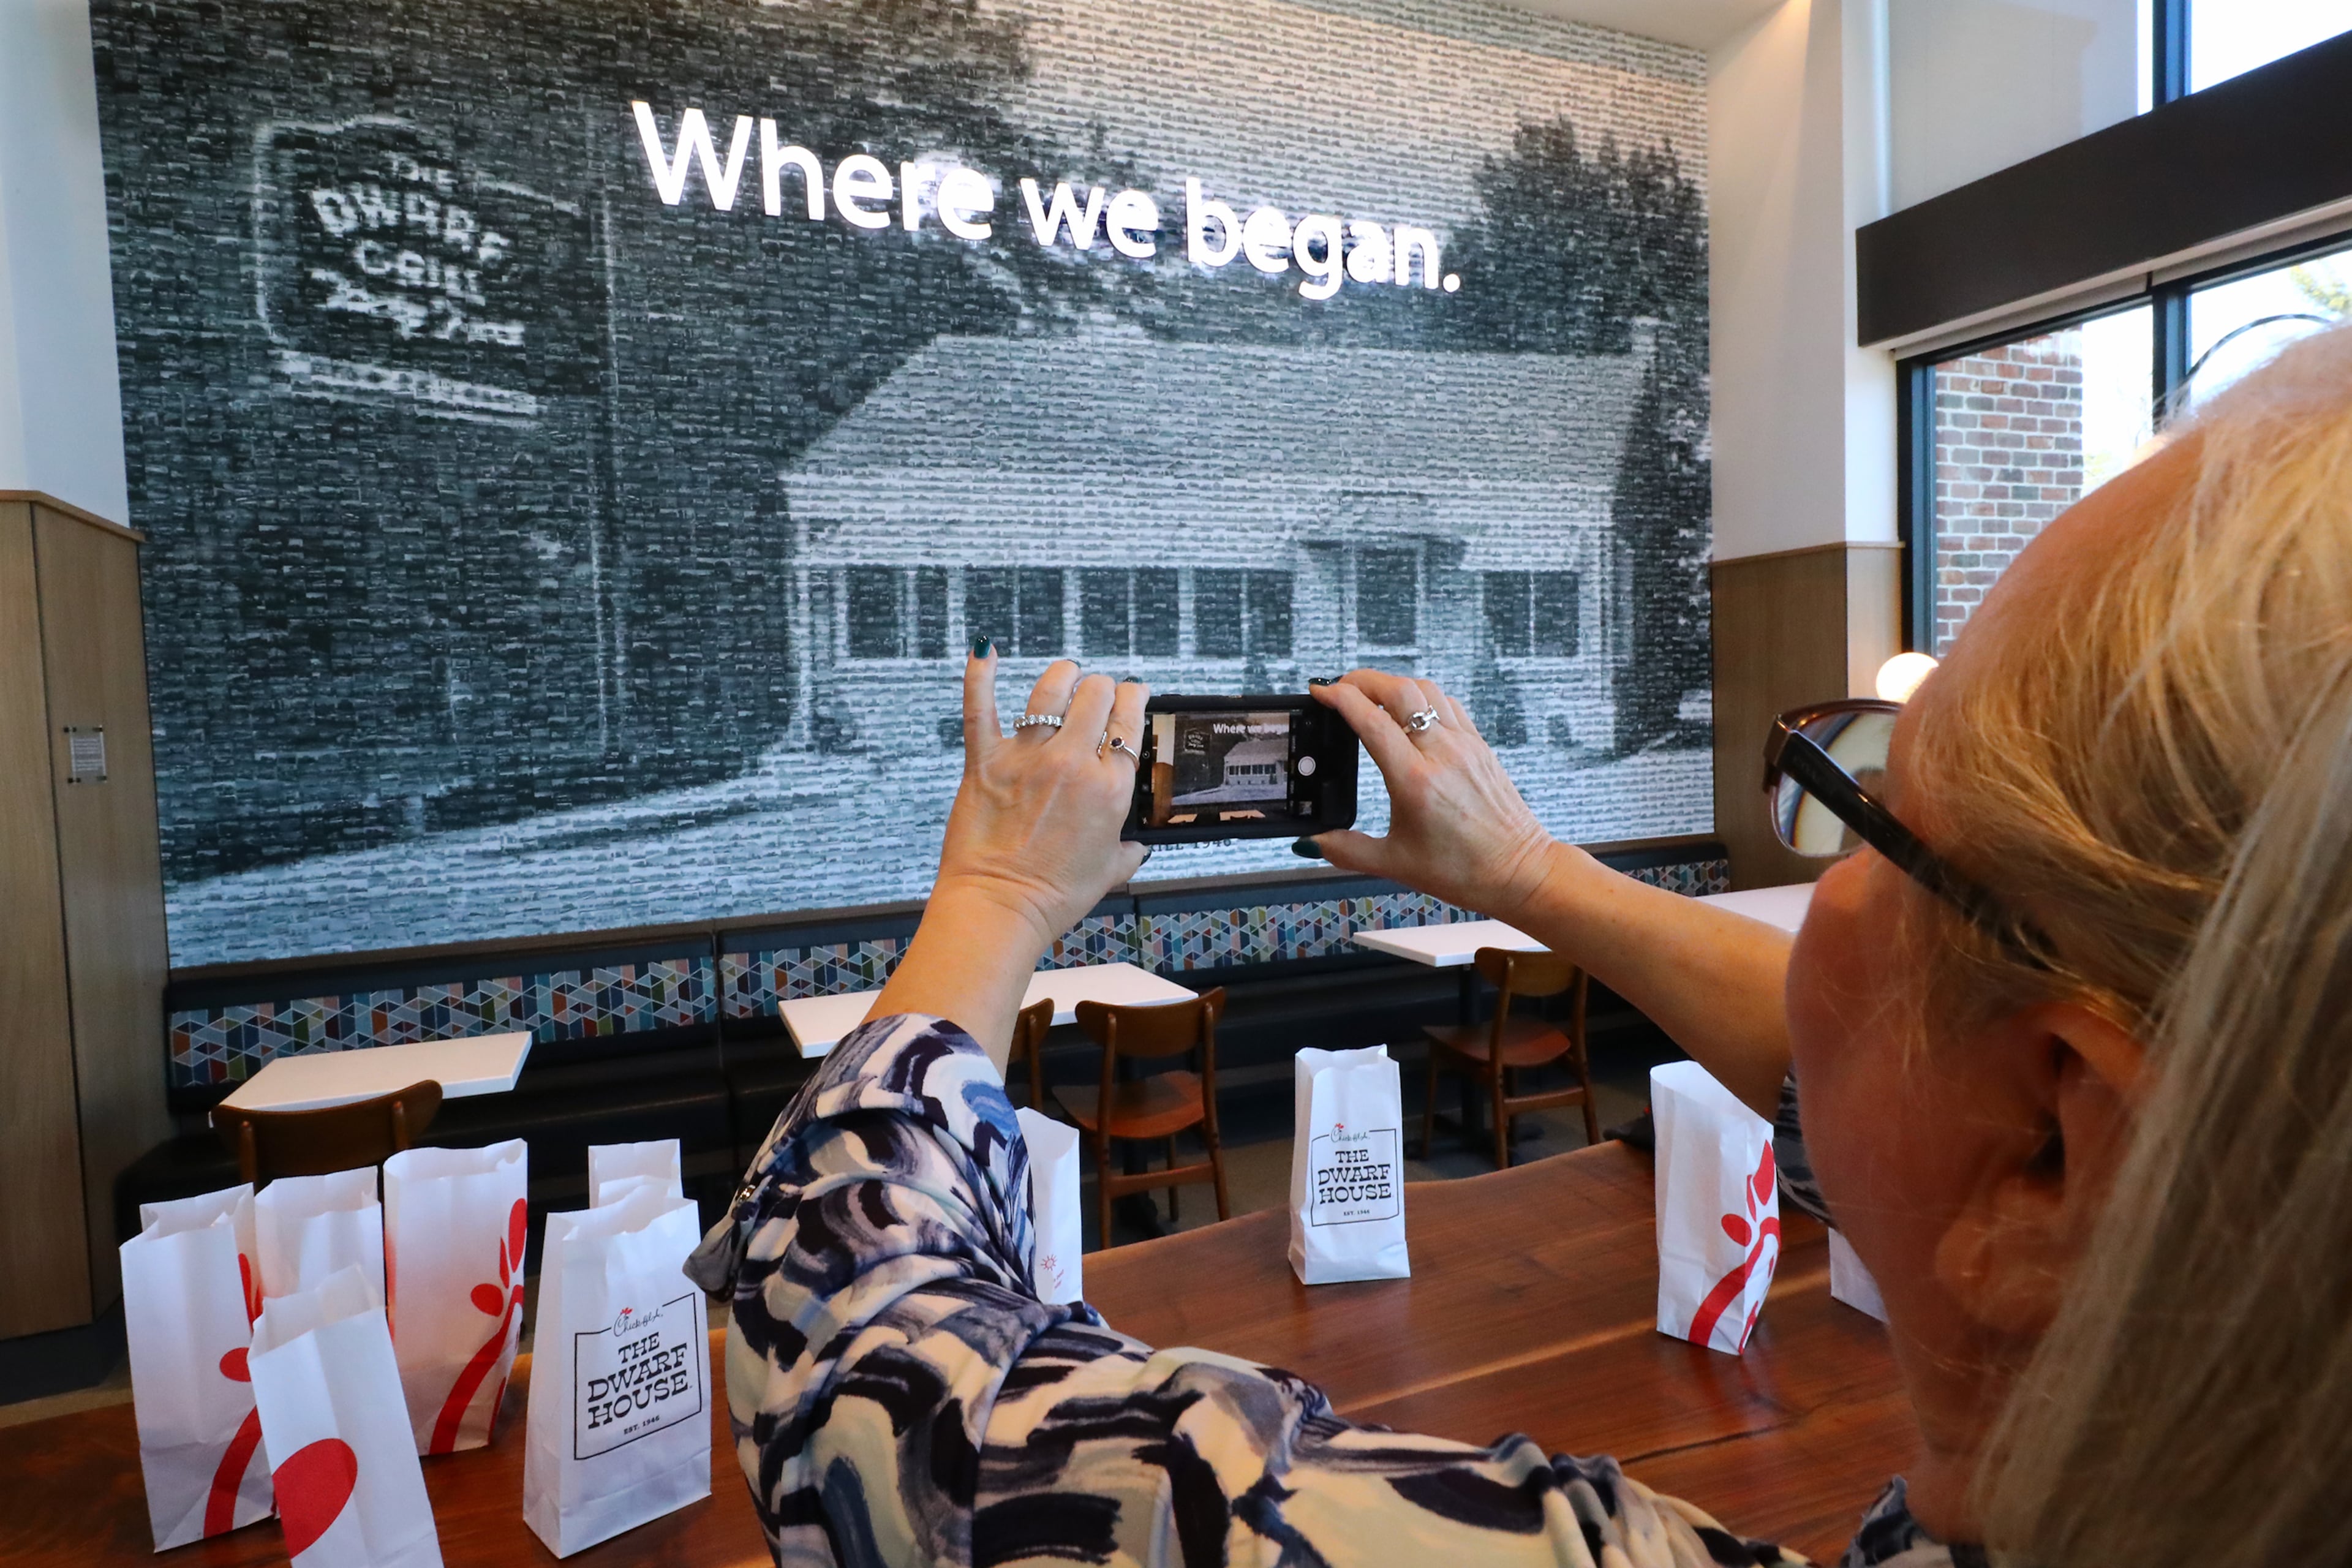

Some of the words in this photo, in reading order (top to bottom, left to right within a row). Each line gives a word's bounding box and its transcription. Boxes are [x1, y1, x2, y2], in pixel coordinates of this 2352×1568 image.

[631, 100, 995, 241] Where
[1019, 177, 1159, 258] we
[1185, 176, 1461, 301] began.
[1213, 723, 1246, 734] Where
[1335, 1149, 1370, 1163] THE
[1317, 1164, 1391, 1186] DWARF
[1319, 1183, 1392, 1205] HOUSE
[618, 1332, 660, 1364] THE
[587, 1343, 687, 1403] DWARF
[587, 1370, 690, 1430] HOUSE
[624, 1424, 640, 1434] EST.
[643, 1415, 660, 1427] 1946
